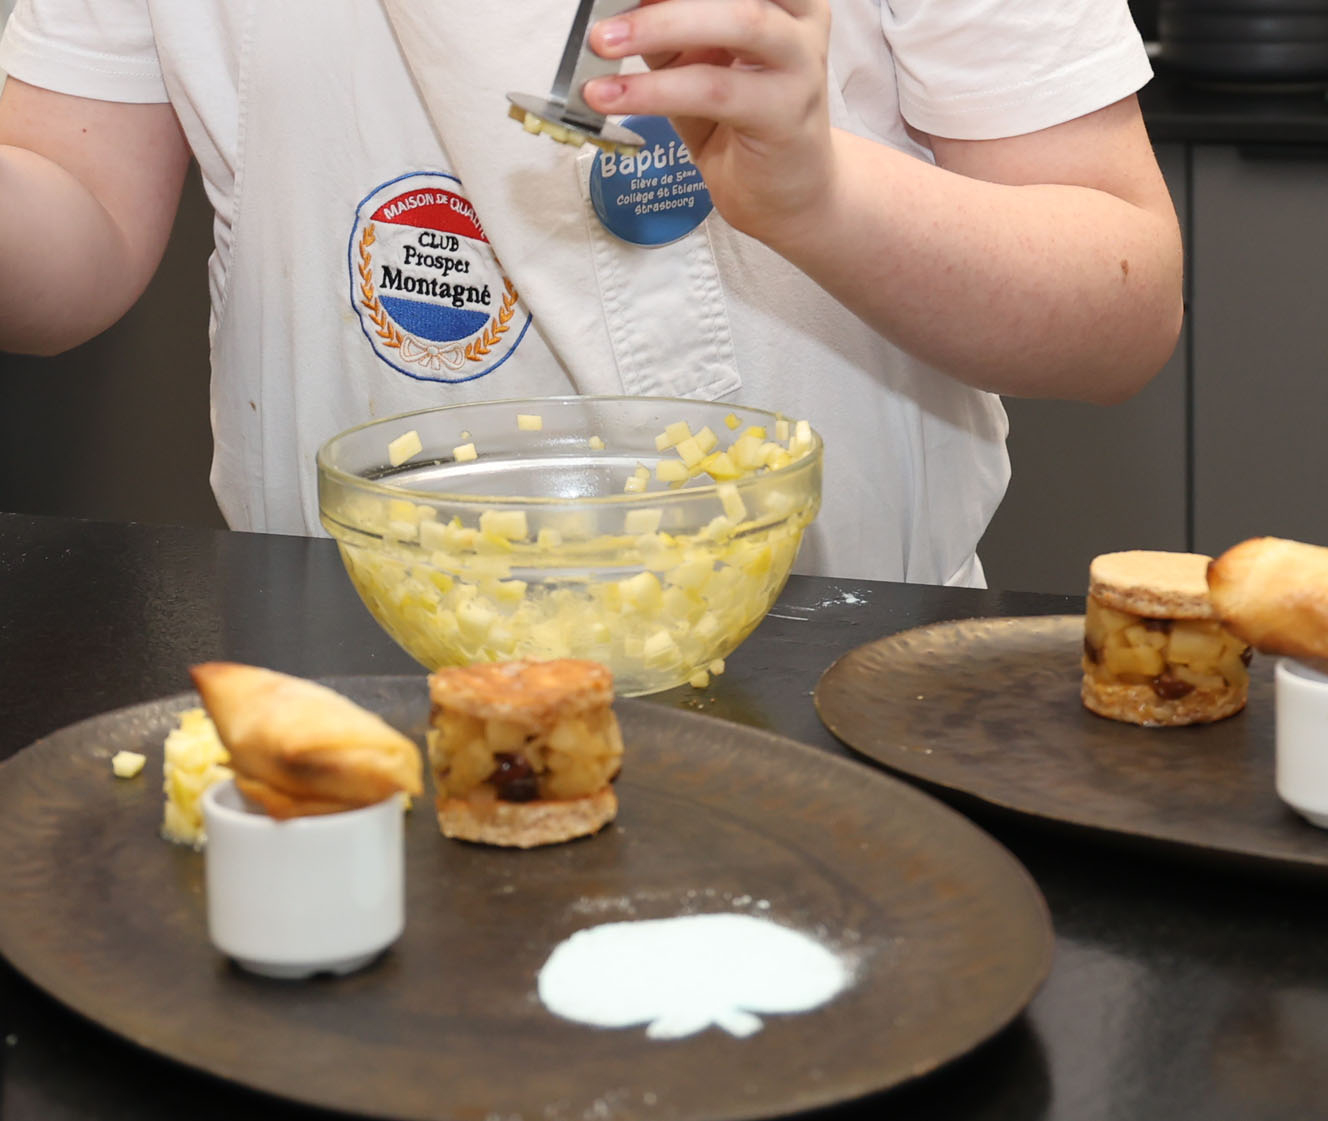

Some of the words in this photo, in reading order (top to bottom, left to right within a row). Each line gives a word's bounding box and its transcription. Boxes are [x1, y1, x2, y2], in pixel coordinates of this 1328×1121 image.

[661, 174, 673, 185] de
[383, 193, 434, 220] MAISON
[436, 193, 449, 205] DE
[617, 191, 654, 206] Collège
[657, 186, 670, 198] St
[635, 196, 695, 215] Strasbourg
[418, 231, 459, 252] CLUB
[403, 245, 470, 277] Prosper
[379, 265, 491, 308] Montagné
